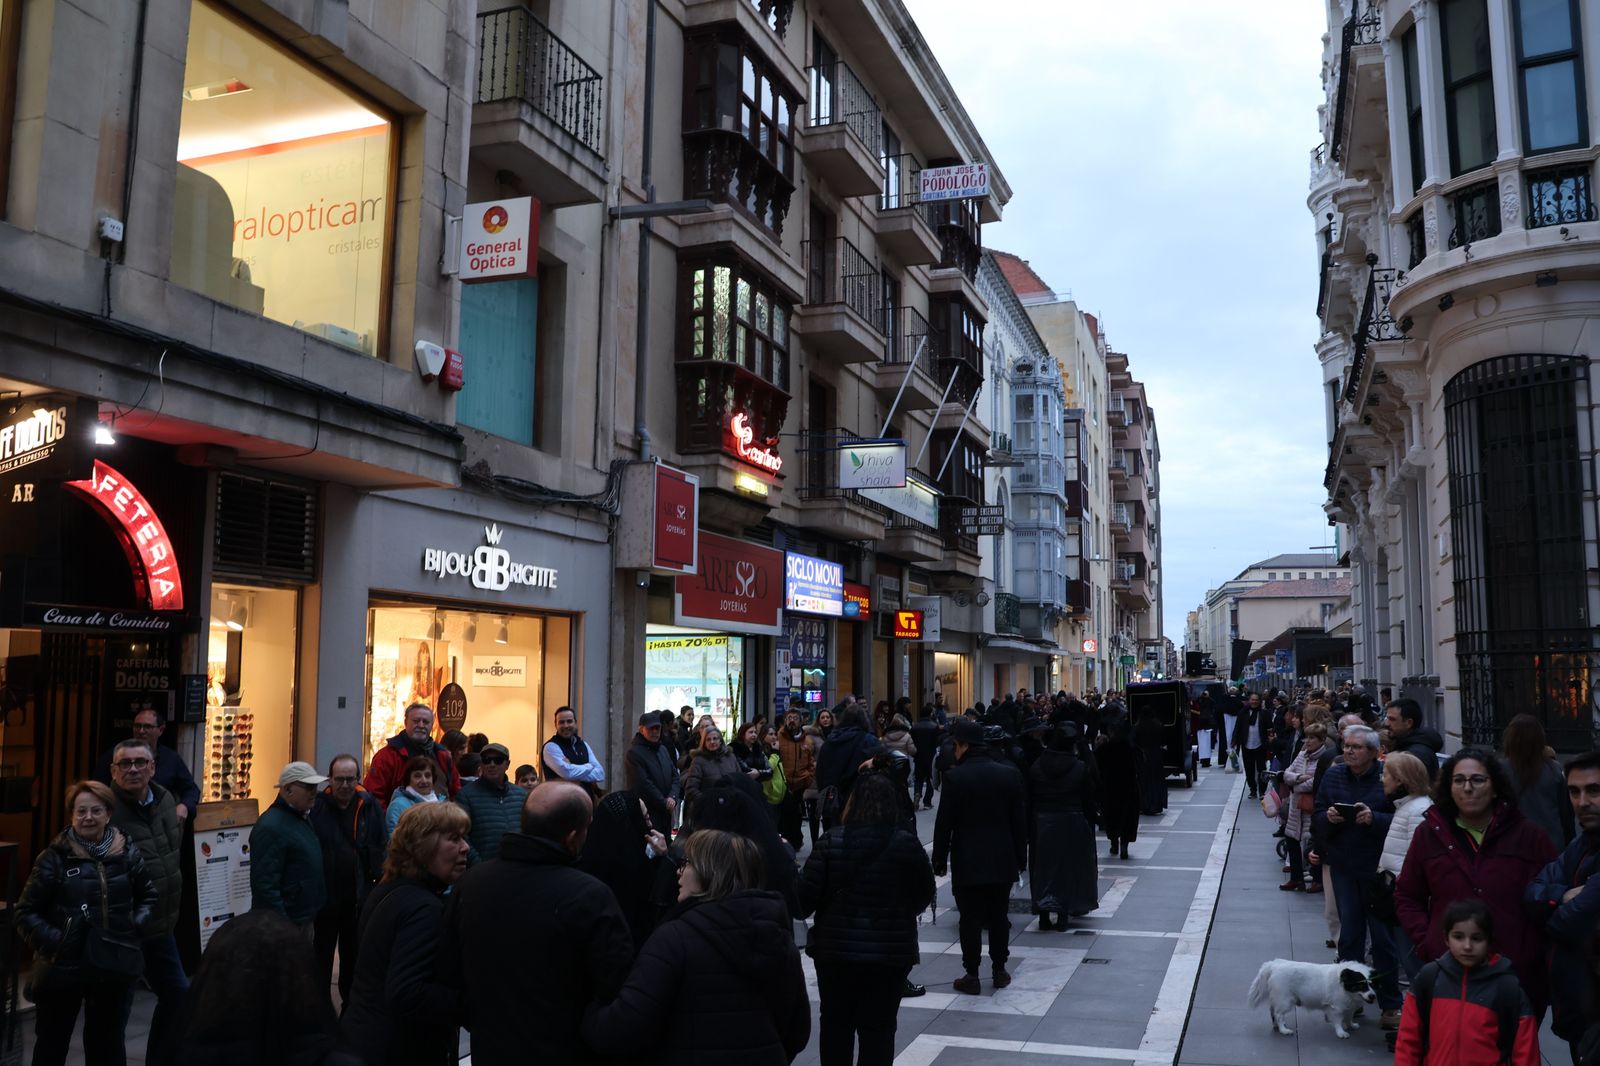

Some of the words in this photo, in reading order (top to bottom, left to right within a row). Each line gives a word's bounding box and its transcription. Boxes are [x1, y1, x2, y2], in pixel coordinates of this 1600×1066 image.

[932, 168, 951, 177] JUAN
[955, 165, 974, 174] JOSE
[922, 172, 986, 192] PODOLOGO
[328, 237, 380, 255] cristales
[466, 238, 521, 256] General
[470, 255, 516, 272] Optica
[425, 547, 473, 579] BIJOU
[787, 555, 814, 581] SIGLO
[815, 561, 842, 587] MOVIL
[719, 599, 747, 613] JOYERÍAS
[43, 608, 81, 625] Casa
[85, 611, 104, 625] de
[109, 612, 170, 629] Comidas
[684, 638, 712, 648] 70%
[114, 671, 169, 689] Dolfos
[442, 699, 465, 719] -10%
